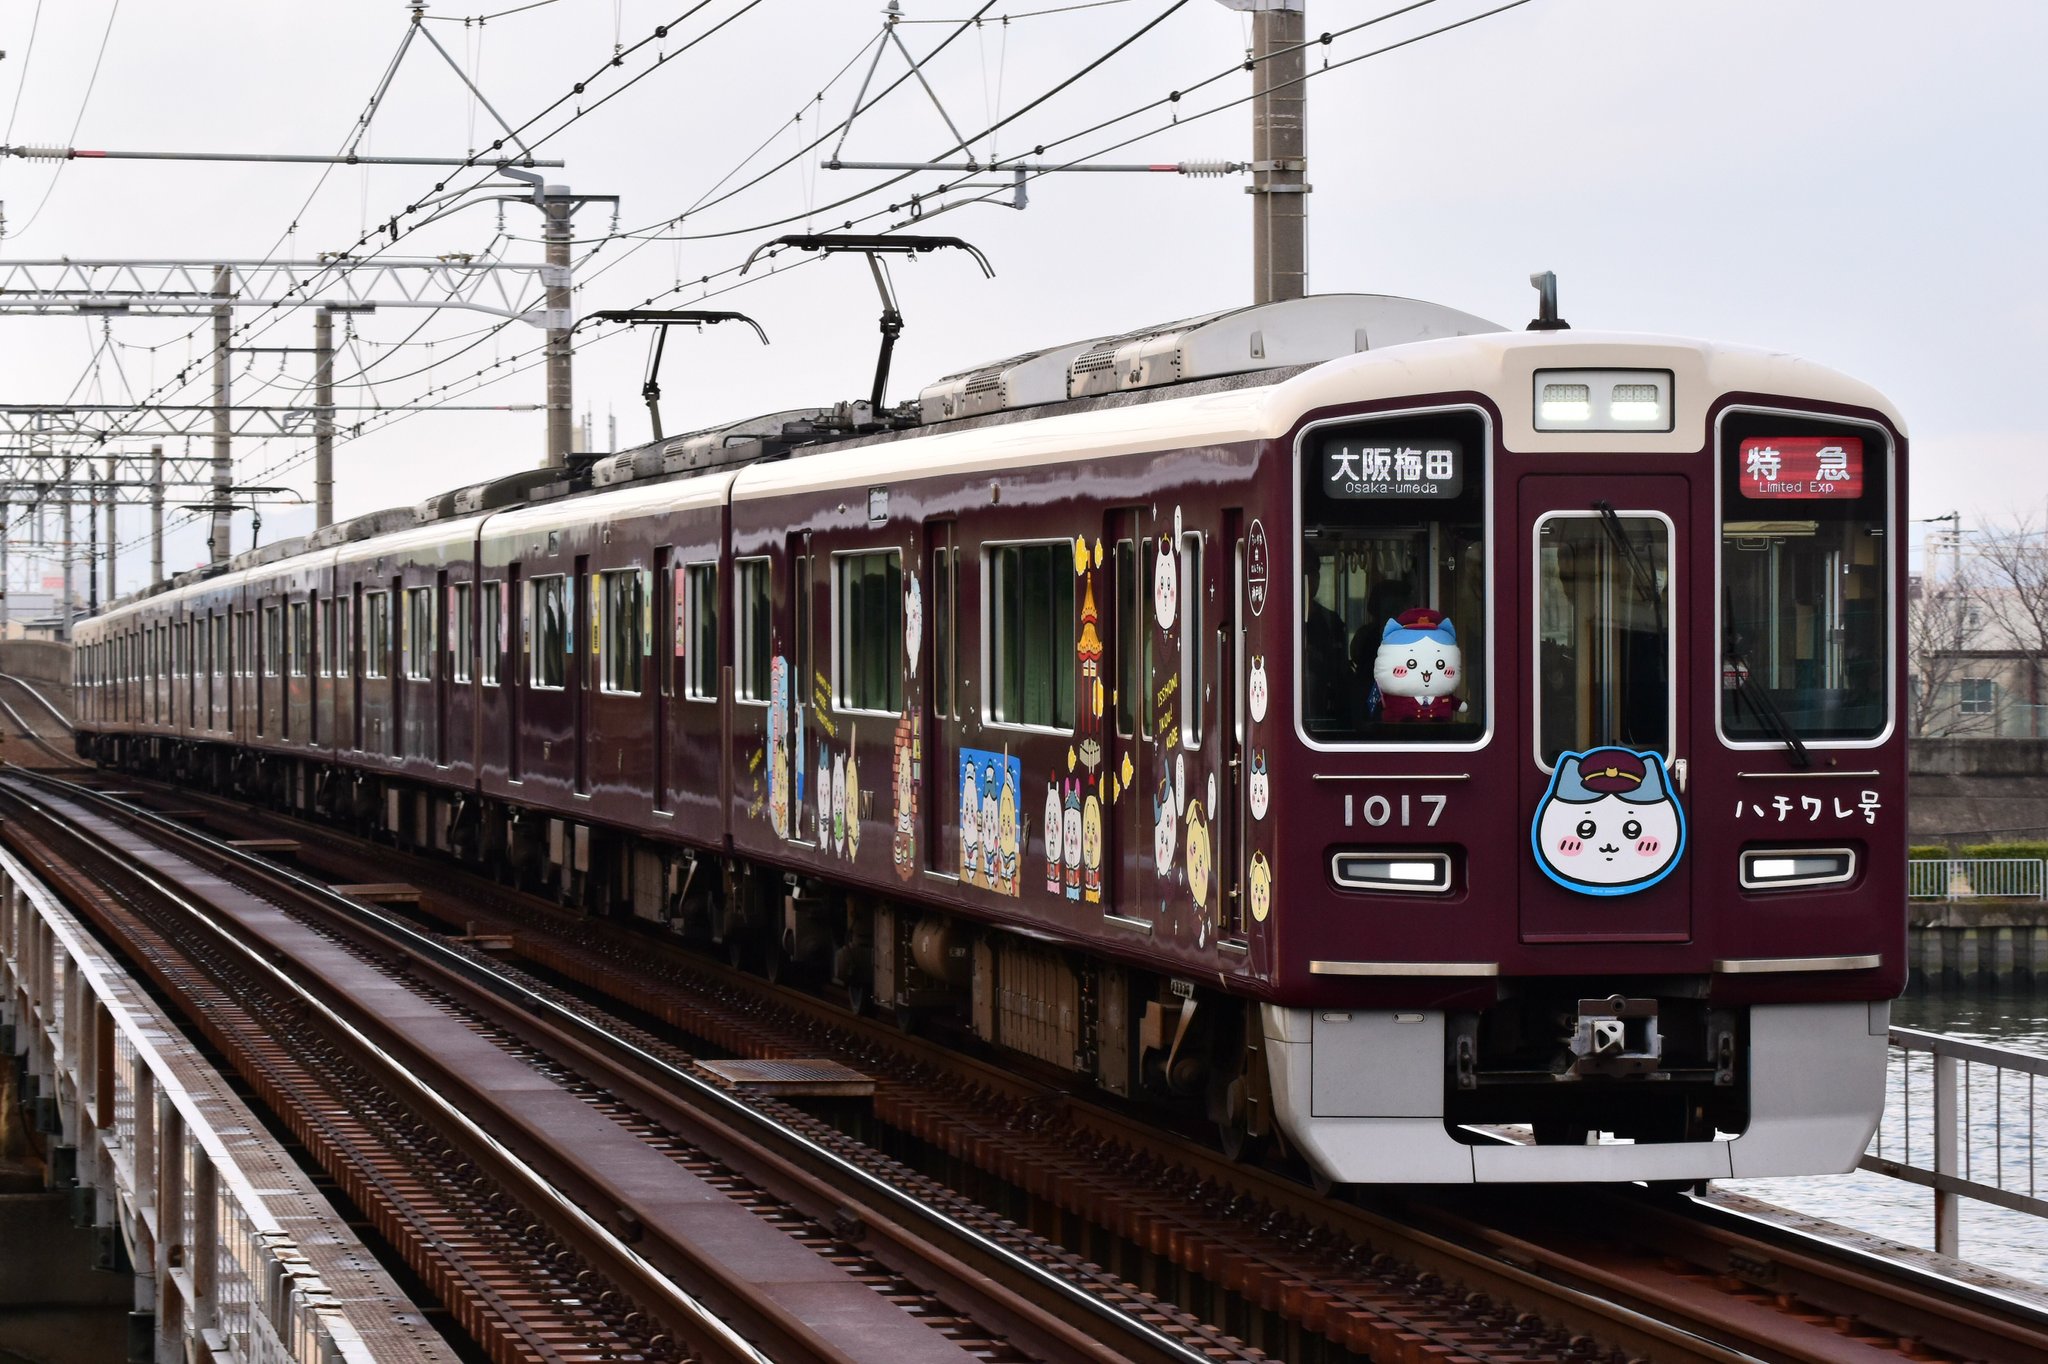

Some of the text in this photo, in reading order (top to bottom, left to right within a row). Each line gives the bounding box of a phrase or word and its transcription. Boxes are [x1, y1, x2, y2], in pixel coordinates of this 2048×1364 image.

[1331, 447, 1453, 481] 大阪梅田
[1345, 482, 1438, 494] Osaka-umeda
[1759, 481, 1836, 494] Limited Exp.
[1345, 795, 1447, 827] 1017
[1735, 790, 1882, 825] ハチワレ号
